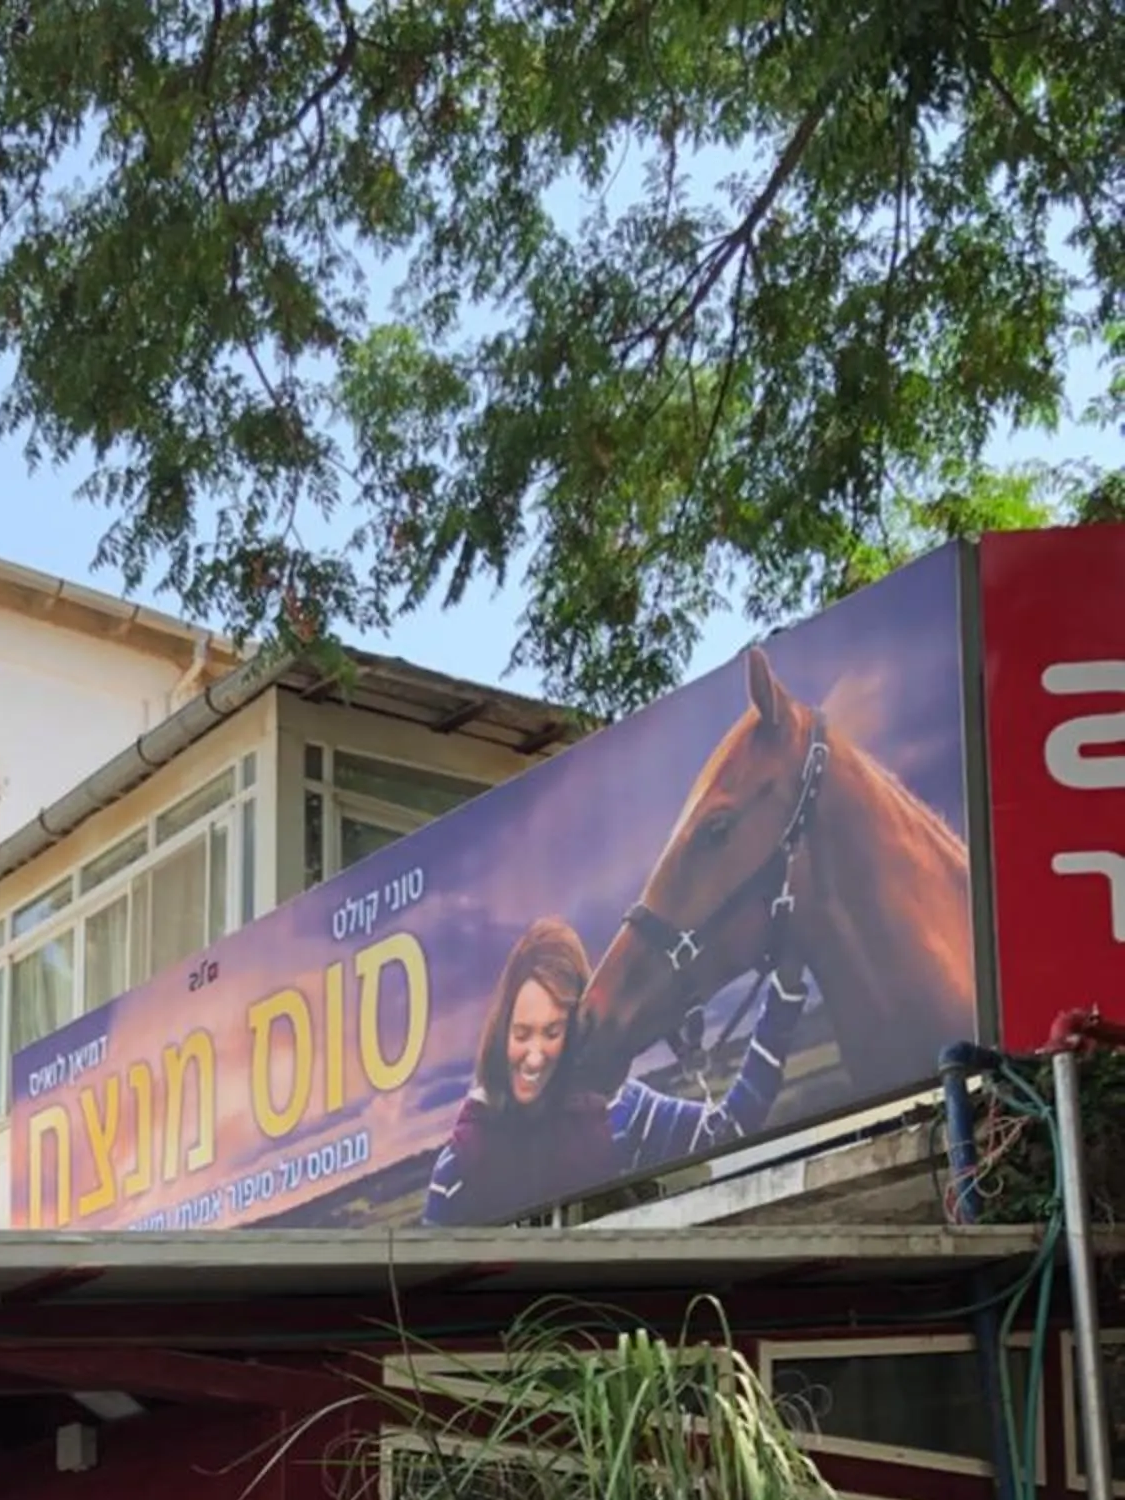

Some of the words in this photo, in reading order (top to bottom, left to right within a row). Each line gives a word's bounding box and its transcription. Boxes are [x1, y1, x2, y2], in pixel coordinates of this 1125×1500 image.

[384, 867, 424, 911] טוני
[333, 890, 379, 940] קולט
[247, 932, 429, 1139] סוס
[28, 1028, 216, 1230] מנצח
[279, 1156, 303, 1192] על
[307, 1132, 369, 1180] מבוסס
[226, 1170, 274, 1211] סיפור
